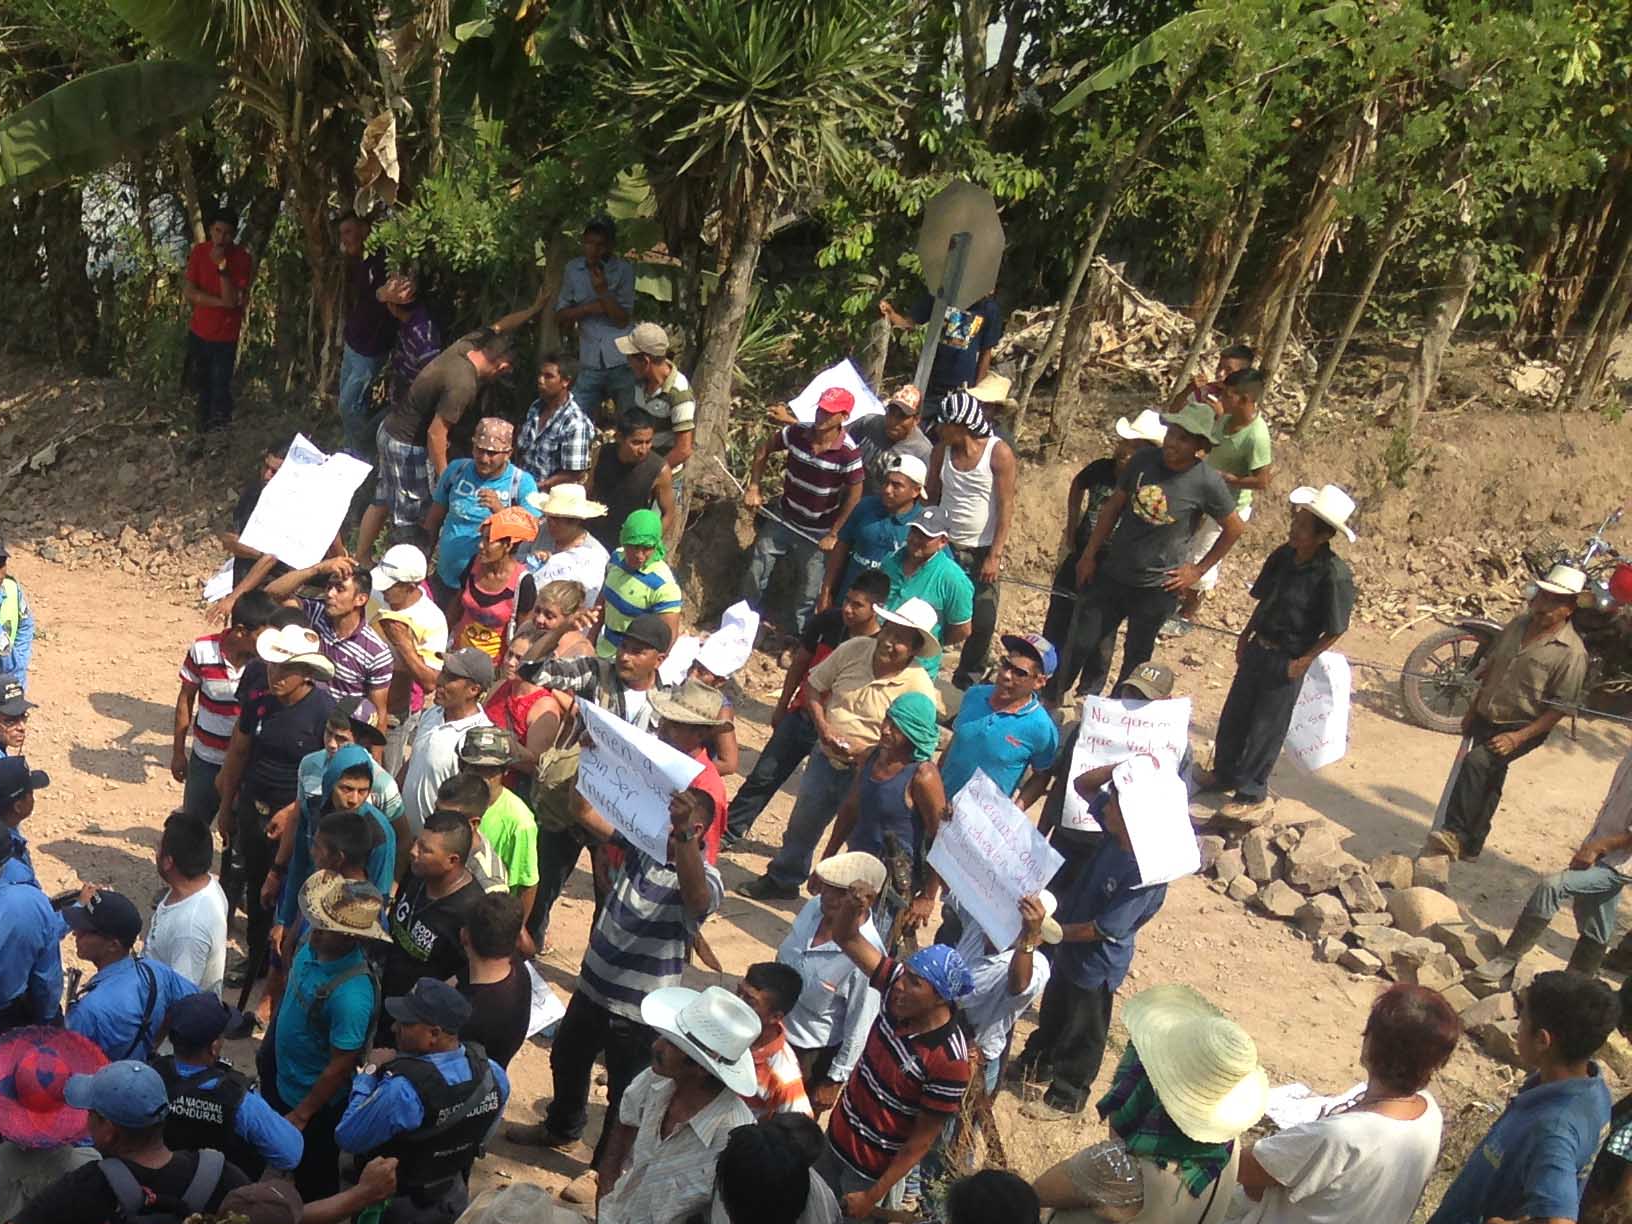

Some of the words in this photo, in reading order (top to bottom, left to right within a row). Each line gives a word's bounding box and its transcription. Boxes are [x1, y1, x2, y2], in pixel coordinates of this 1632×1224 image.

[1140, 667, 1161, 682] CAT
[1091, 706, 1111, 724] No
[168, 1103, 223, 1124] HONDURAS
[185, 1096, 223, 1114] NACIONAL
